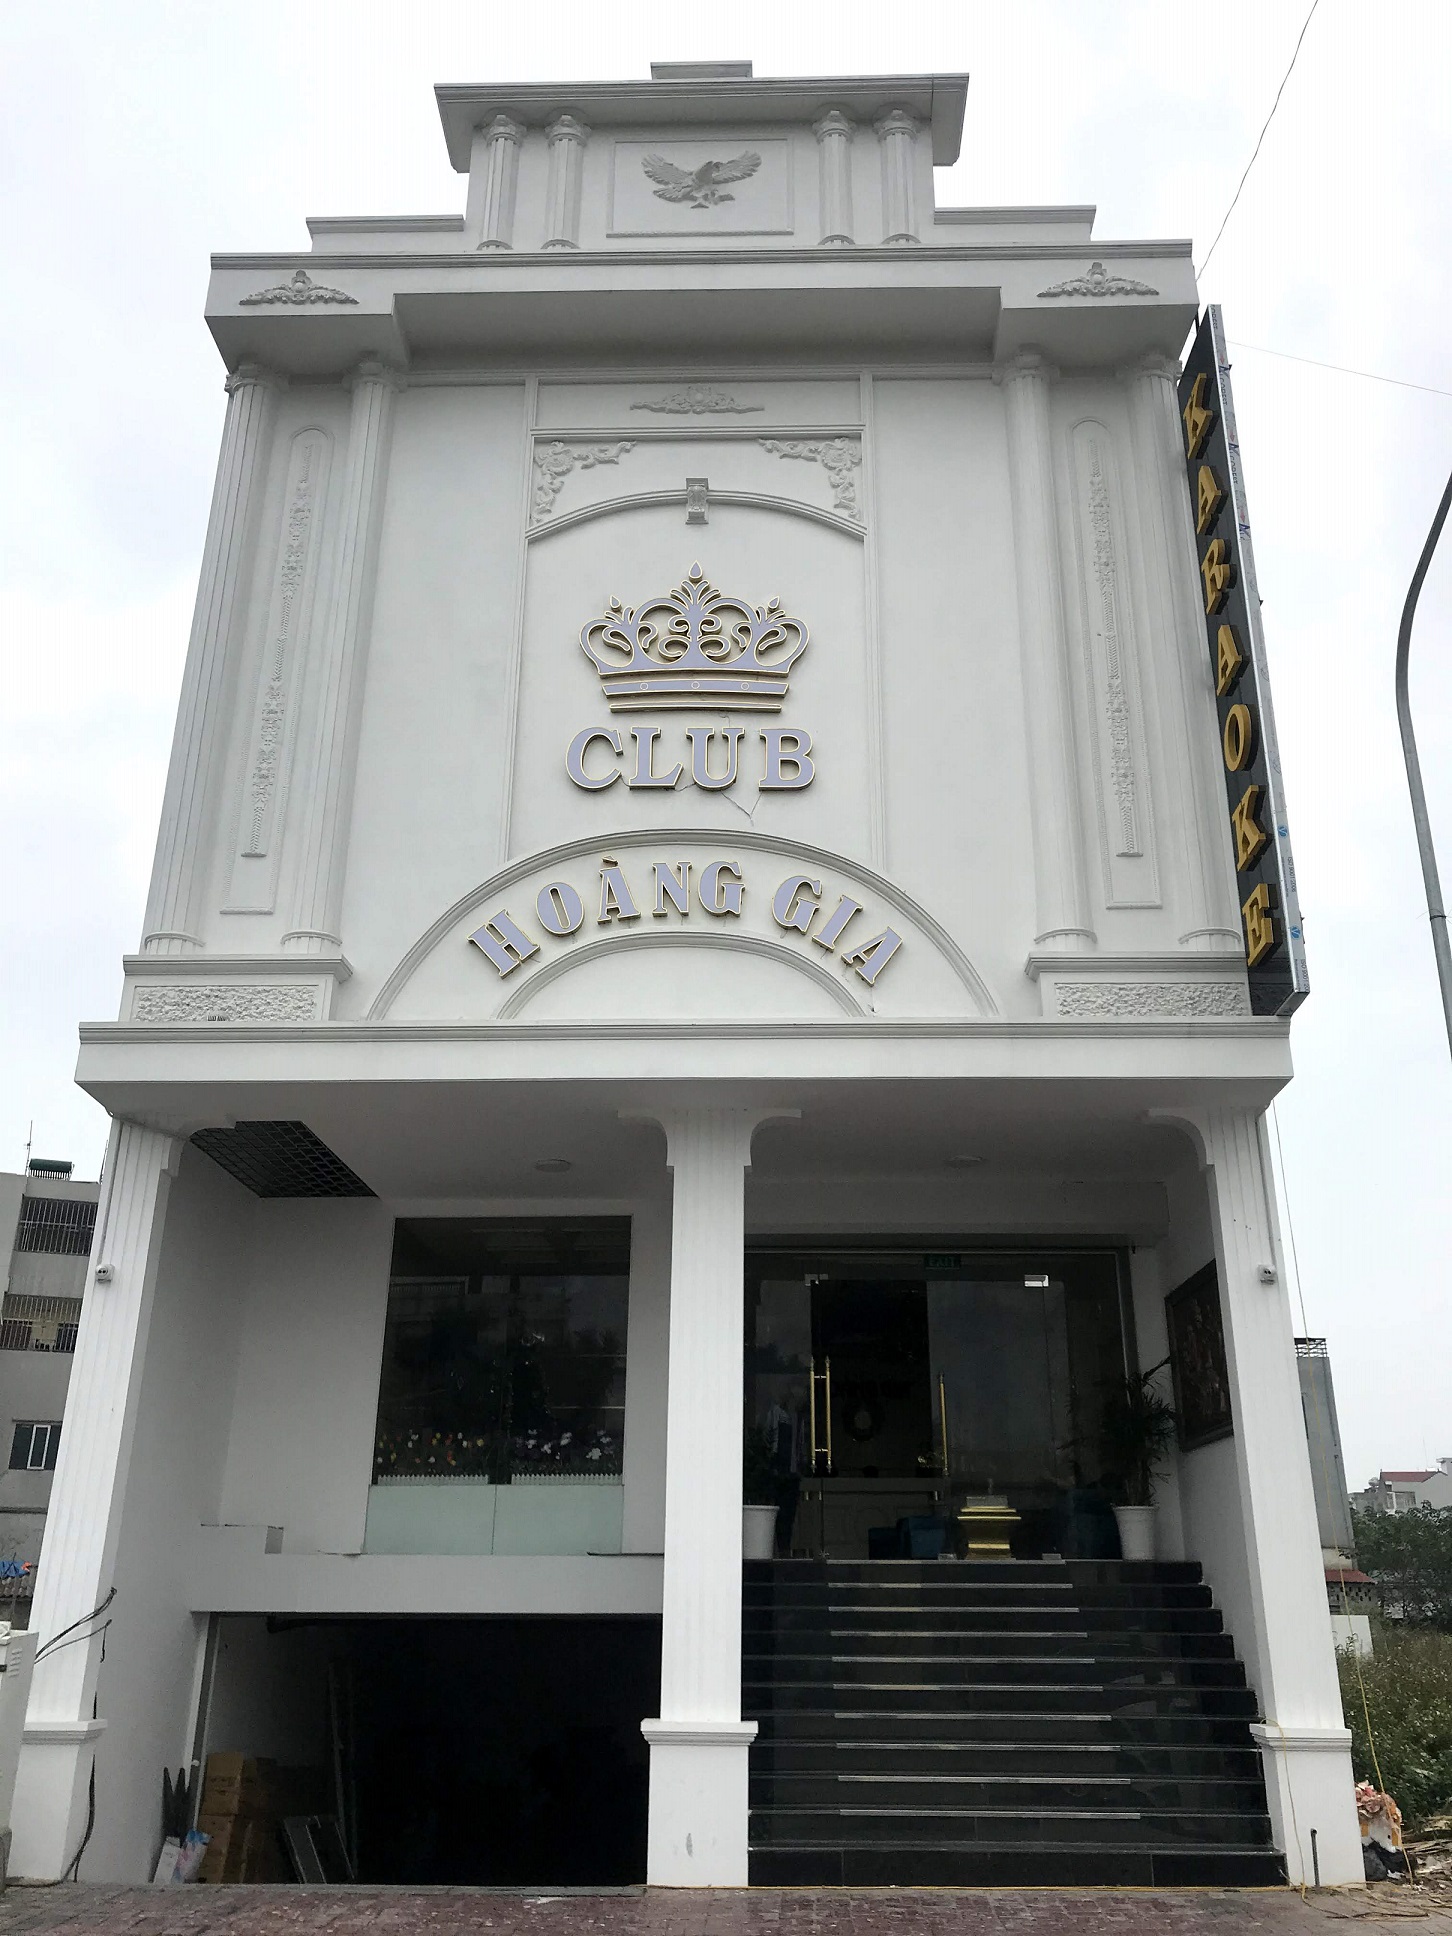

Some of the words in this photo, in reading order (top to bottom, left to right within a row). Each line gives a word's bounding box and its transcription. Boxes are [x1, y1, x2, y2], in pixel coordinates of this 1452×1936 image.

[1183, 372, 1274, 966] KARAOKE
[566, 726, 815, 791] CLUB
[466, 856, 746, 979] HOÀNG
[771, 874, 904, 987] GIA
